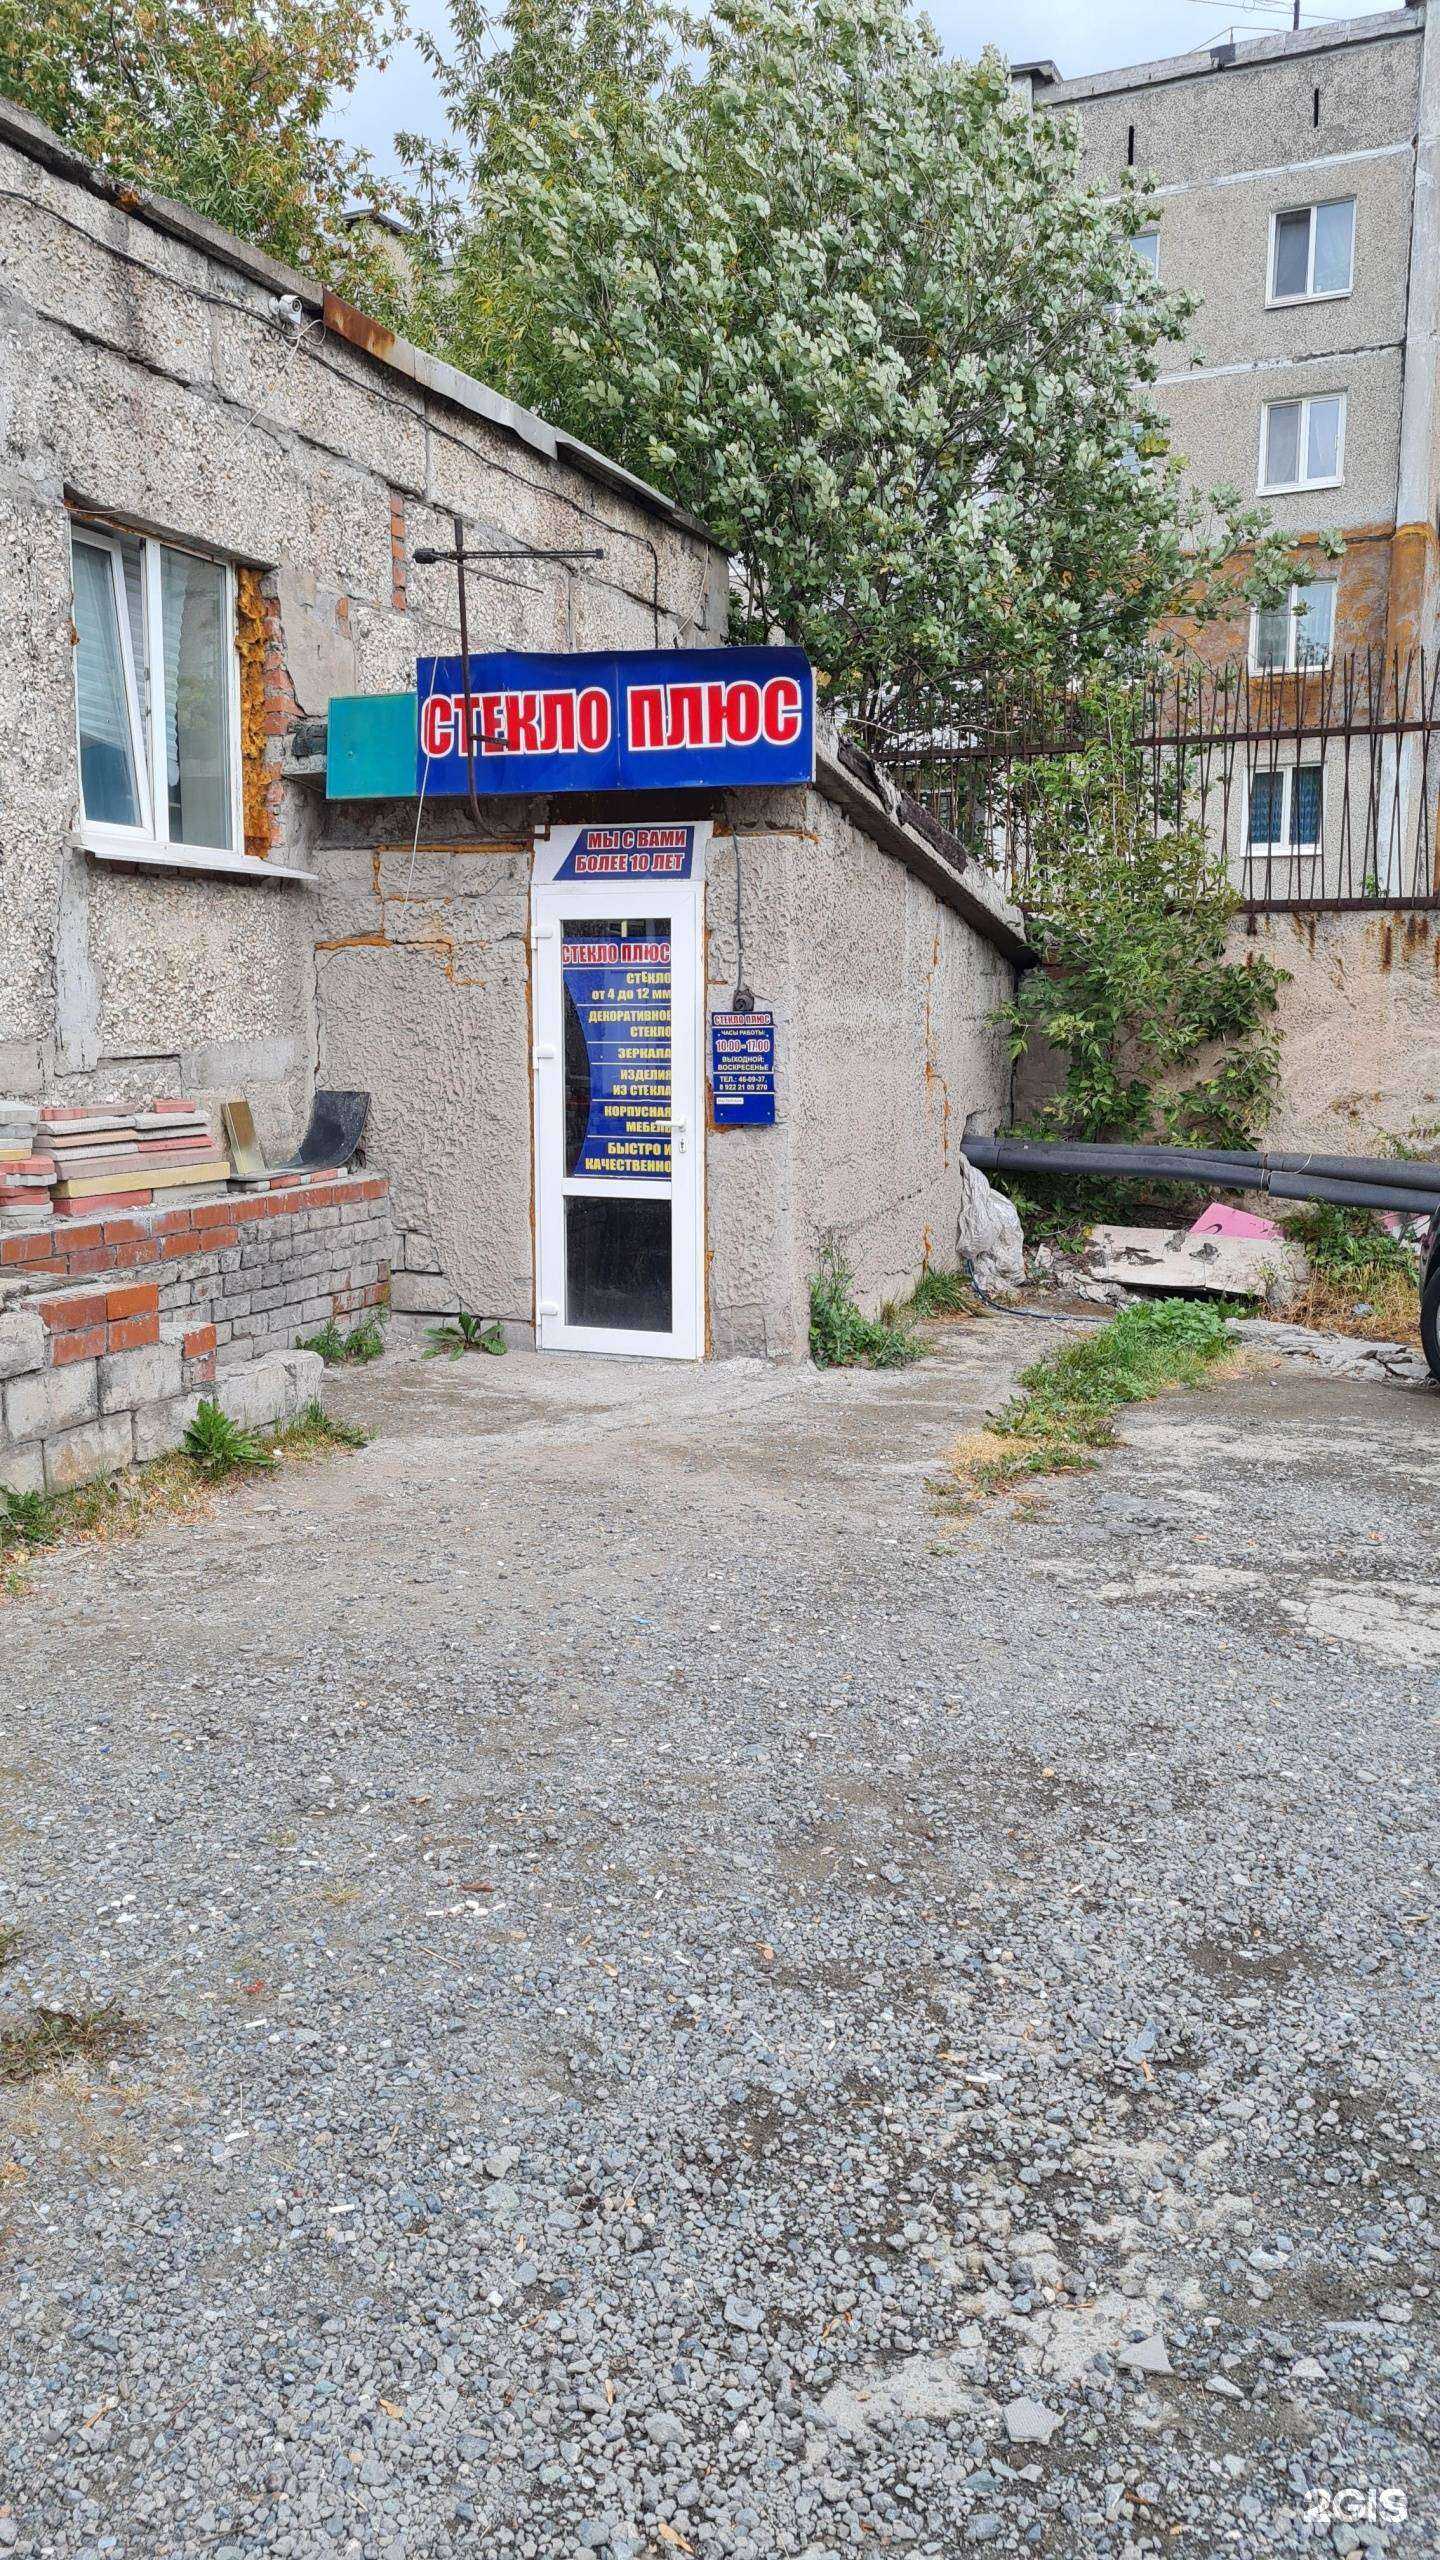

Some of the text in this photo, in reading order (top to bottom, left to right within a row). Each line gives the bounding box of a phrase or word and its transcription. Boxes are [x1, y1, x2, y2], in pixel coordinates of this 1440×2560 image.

[420, 677, 802, 759] СТЕКЛО ПЛЮС
[587, 829, 687, 849] МЫ С ВАМИ
[575, 853, 685, 873] БОЛЕЕ 10 ЛЕТ
[562, 943, 671, 964] СТЕКЛО ПЛЮС
[592, 990, 605, 1000] от
[607, 988, 615, 999] 4
[617, 989, 634, 1001] до
[636, 987, 649, 999] 12
[713, 1013, 771, 1026] СТЕКЛО ПЛЮС
[630, 1026, 671, 1038] СТЕКЛО
[617, 1047, 671, 1059] ЗЕРКАЛА
[620, 1069, 671, 1081] ИЗДЕЛИЯ
[612, 1084, 671, 1096] ИЗ СТЕКЛА
[604, 1105, 671, 1117] КОРПУСНАЯ
[607, 1142, 671, 1155] БЫСТРО И
[585, 1157, 671, 1172] КАЧЕСТВЕННО
